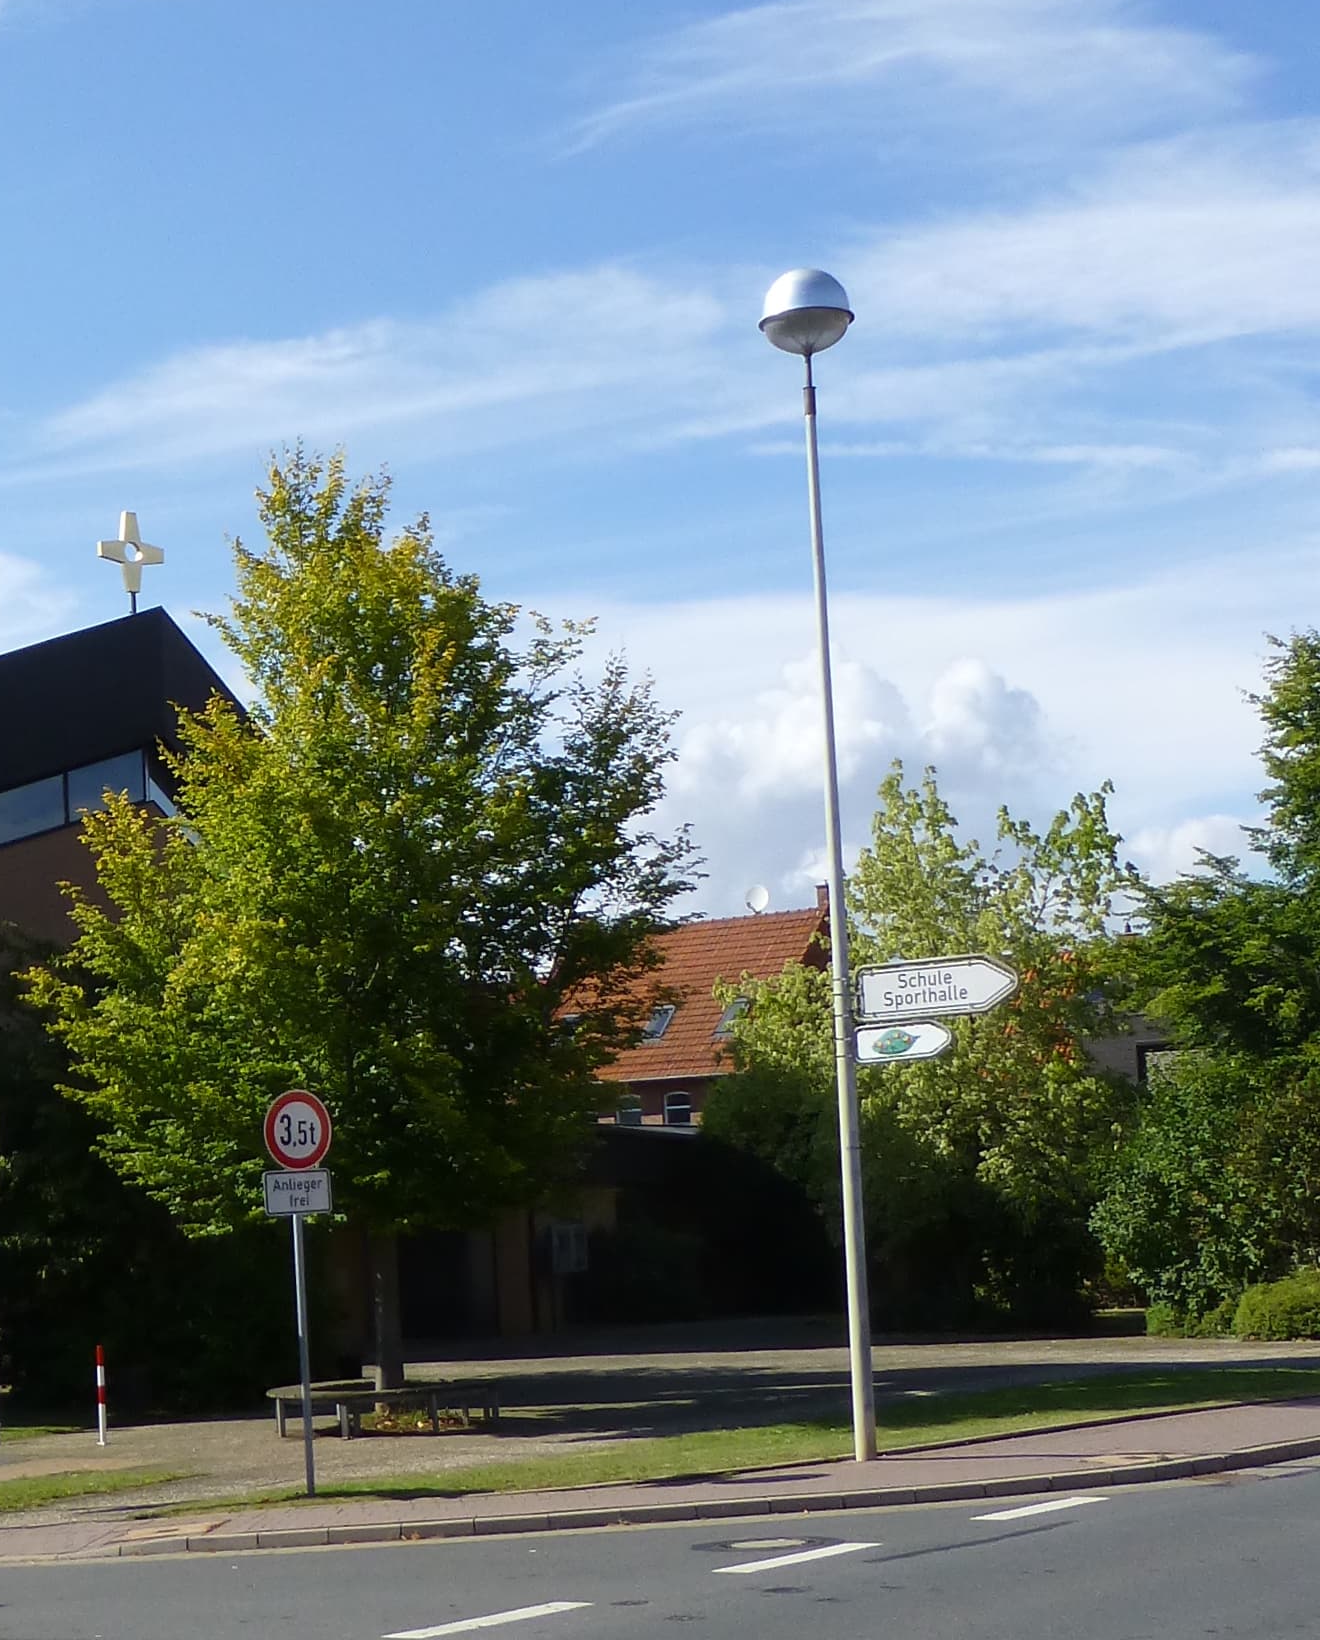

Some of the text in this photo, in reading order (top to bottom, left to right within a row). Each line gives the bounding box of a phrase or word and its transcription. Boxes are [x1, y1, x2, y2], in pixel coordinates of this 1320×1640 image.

[898, 971, 952, 989] Schule
[884, 985, 968, 1009] Sporthalle
[273, 1179, 322, 1193] Anlieger
[289, 1194, 310, 1208] frei
